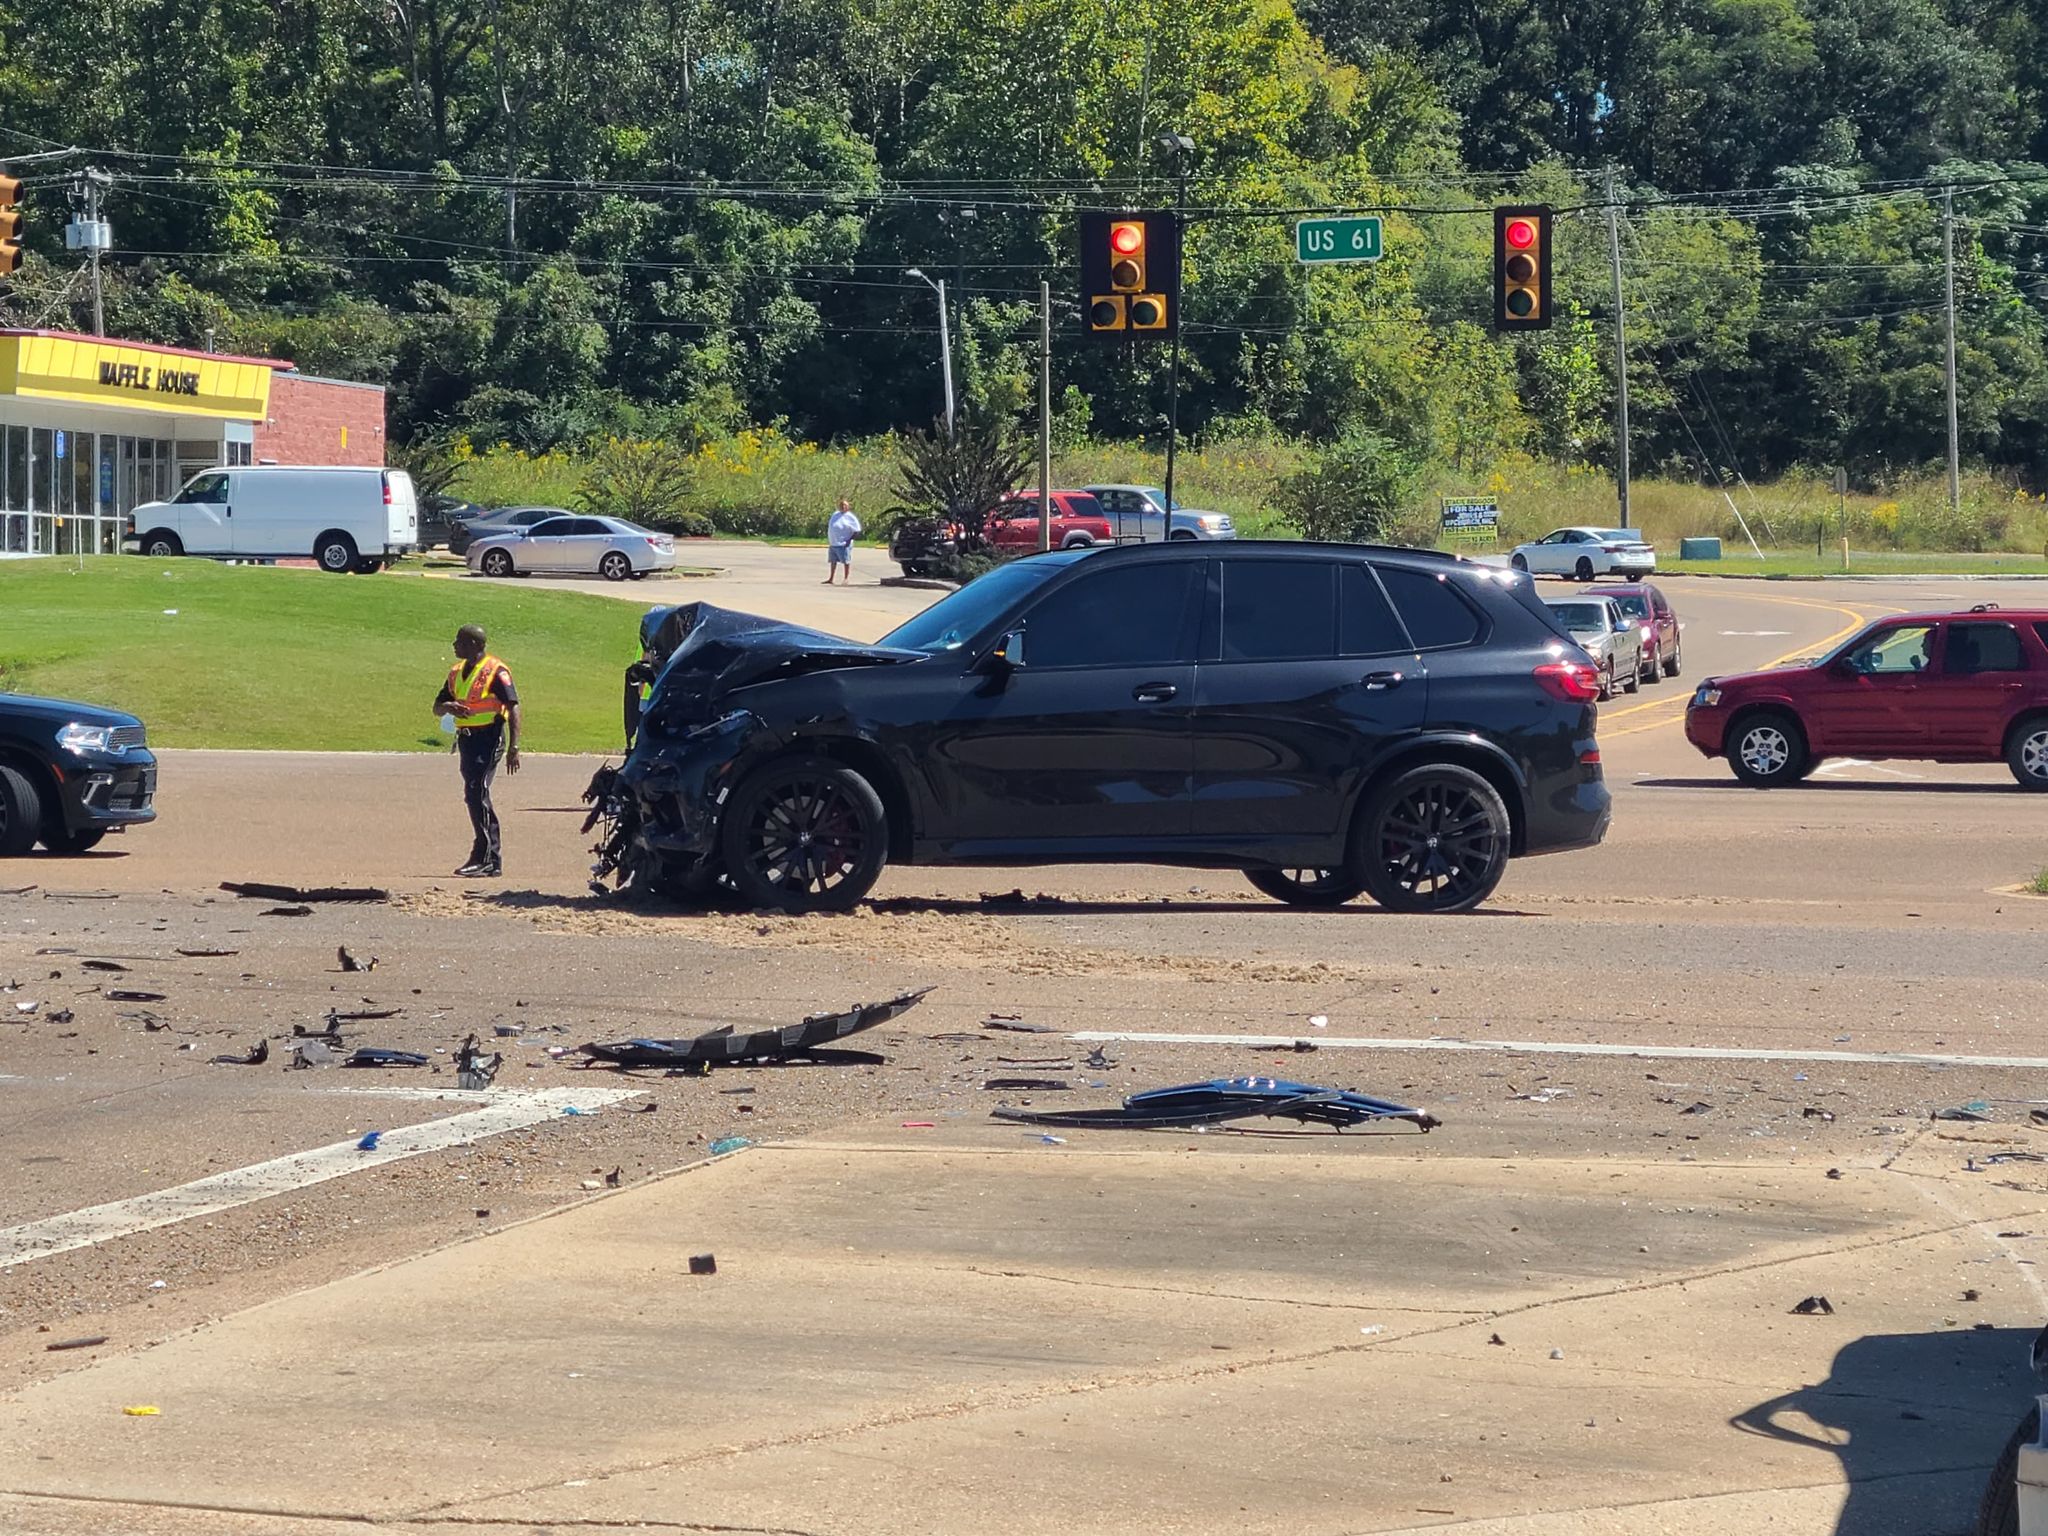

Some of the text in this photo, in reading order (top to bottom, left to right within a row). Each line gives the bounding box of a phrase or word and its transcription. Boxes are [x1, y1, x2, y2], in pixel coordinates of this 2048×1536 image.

[1307, 227, 1372, 252] US 61
[99, 361, 200, 396] WAFFLE HOUSE
[1450, 505, 1468, 513] FOR
